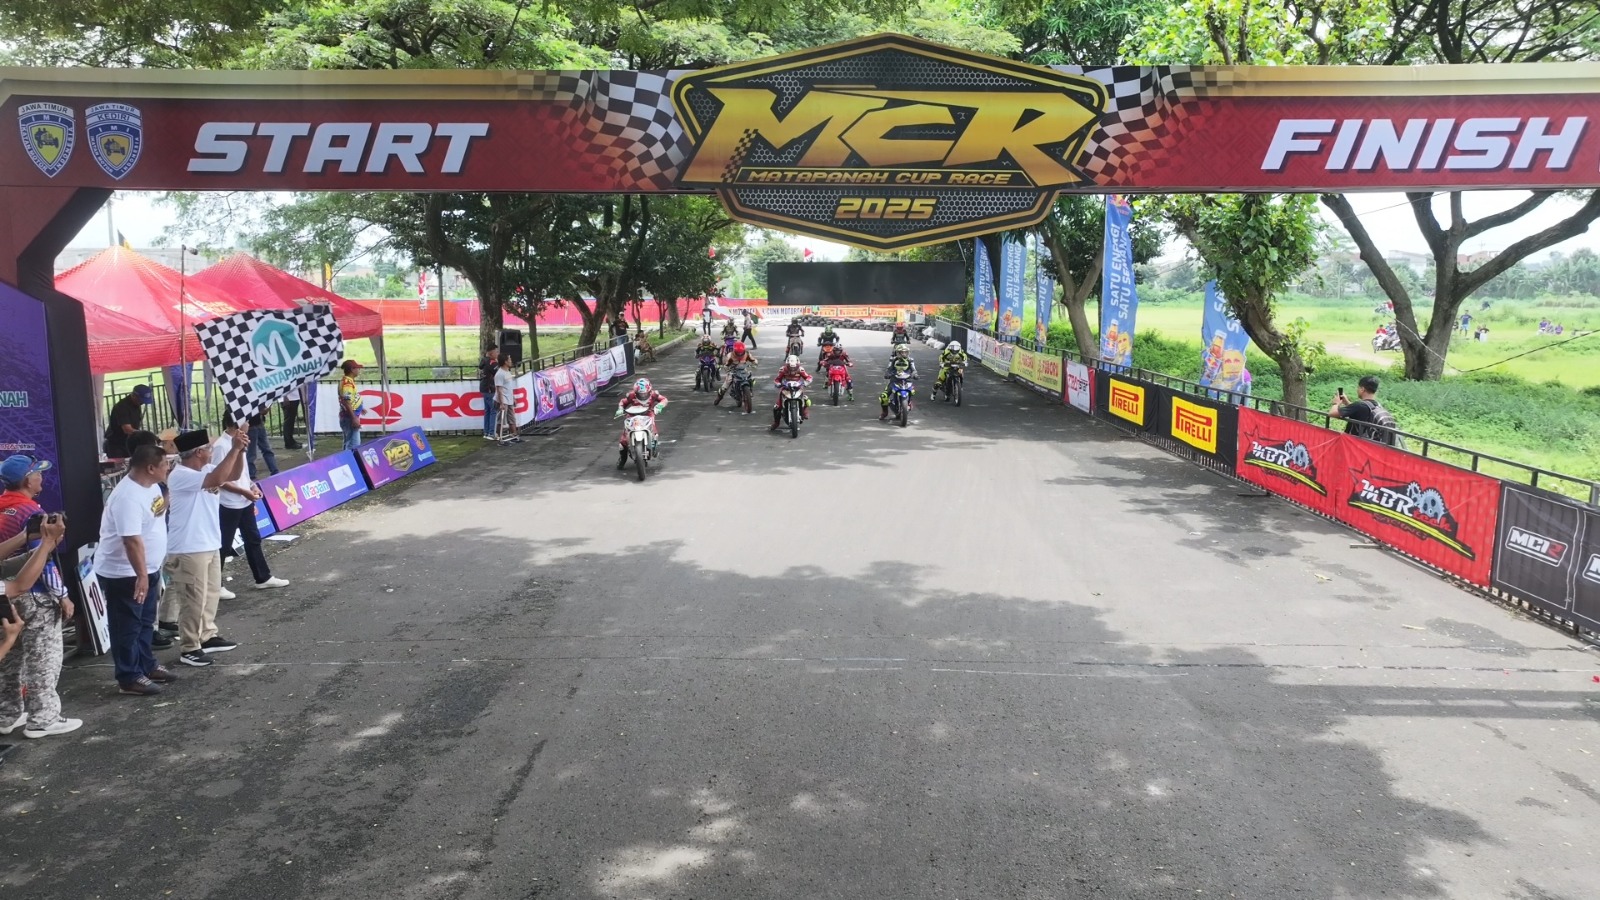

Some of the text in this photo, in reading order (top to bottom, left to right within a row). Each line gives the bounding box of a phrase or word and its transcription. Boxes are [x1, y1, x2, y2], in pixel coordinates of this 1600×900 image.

[21, 103, 68, 115] JAWA TIMUR
[91, 105, 135, 114] JAWA TIMUR
[97, 113, 130, 122] KEDIRI
[54, 127, 74, 172] INDONESIA
[187, 122, 489, 173] START
[681, 88, 1096, 187] MCR
[1260, 116, 1588, 170] FINISH
[749, 171, 1012, 185] MATAPANAH CUP RACE
[834, 198, 937, 219] 2025
[1006, 279, 1014, 299] SATU
[1012, 241, 1022, 308] SATU SEMANGA
[1110, 273, 1119, 307] SATU
[1118, 285, 1132, 320] SATU
[252, 357, 323, 393] MATAPANAH
[1111, 386, 1140, 416] PIRELLI
[1175, 406, 1213, 443] PIRELLI
[302, 482, 330, 499] Mapan
[88, 581, 104, 621] 10
